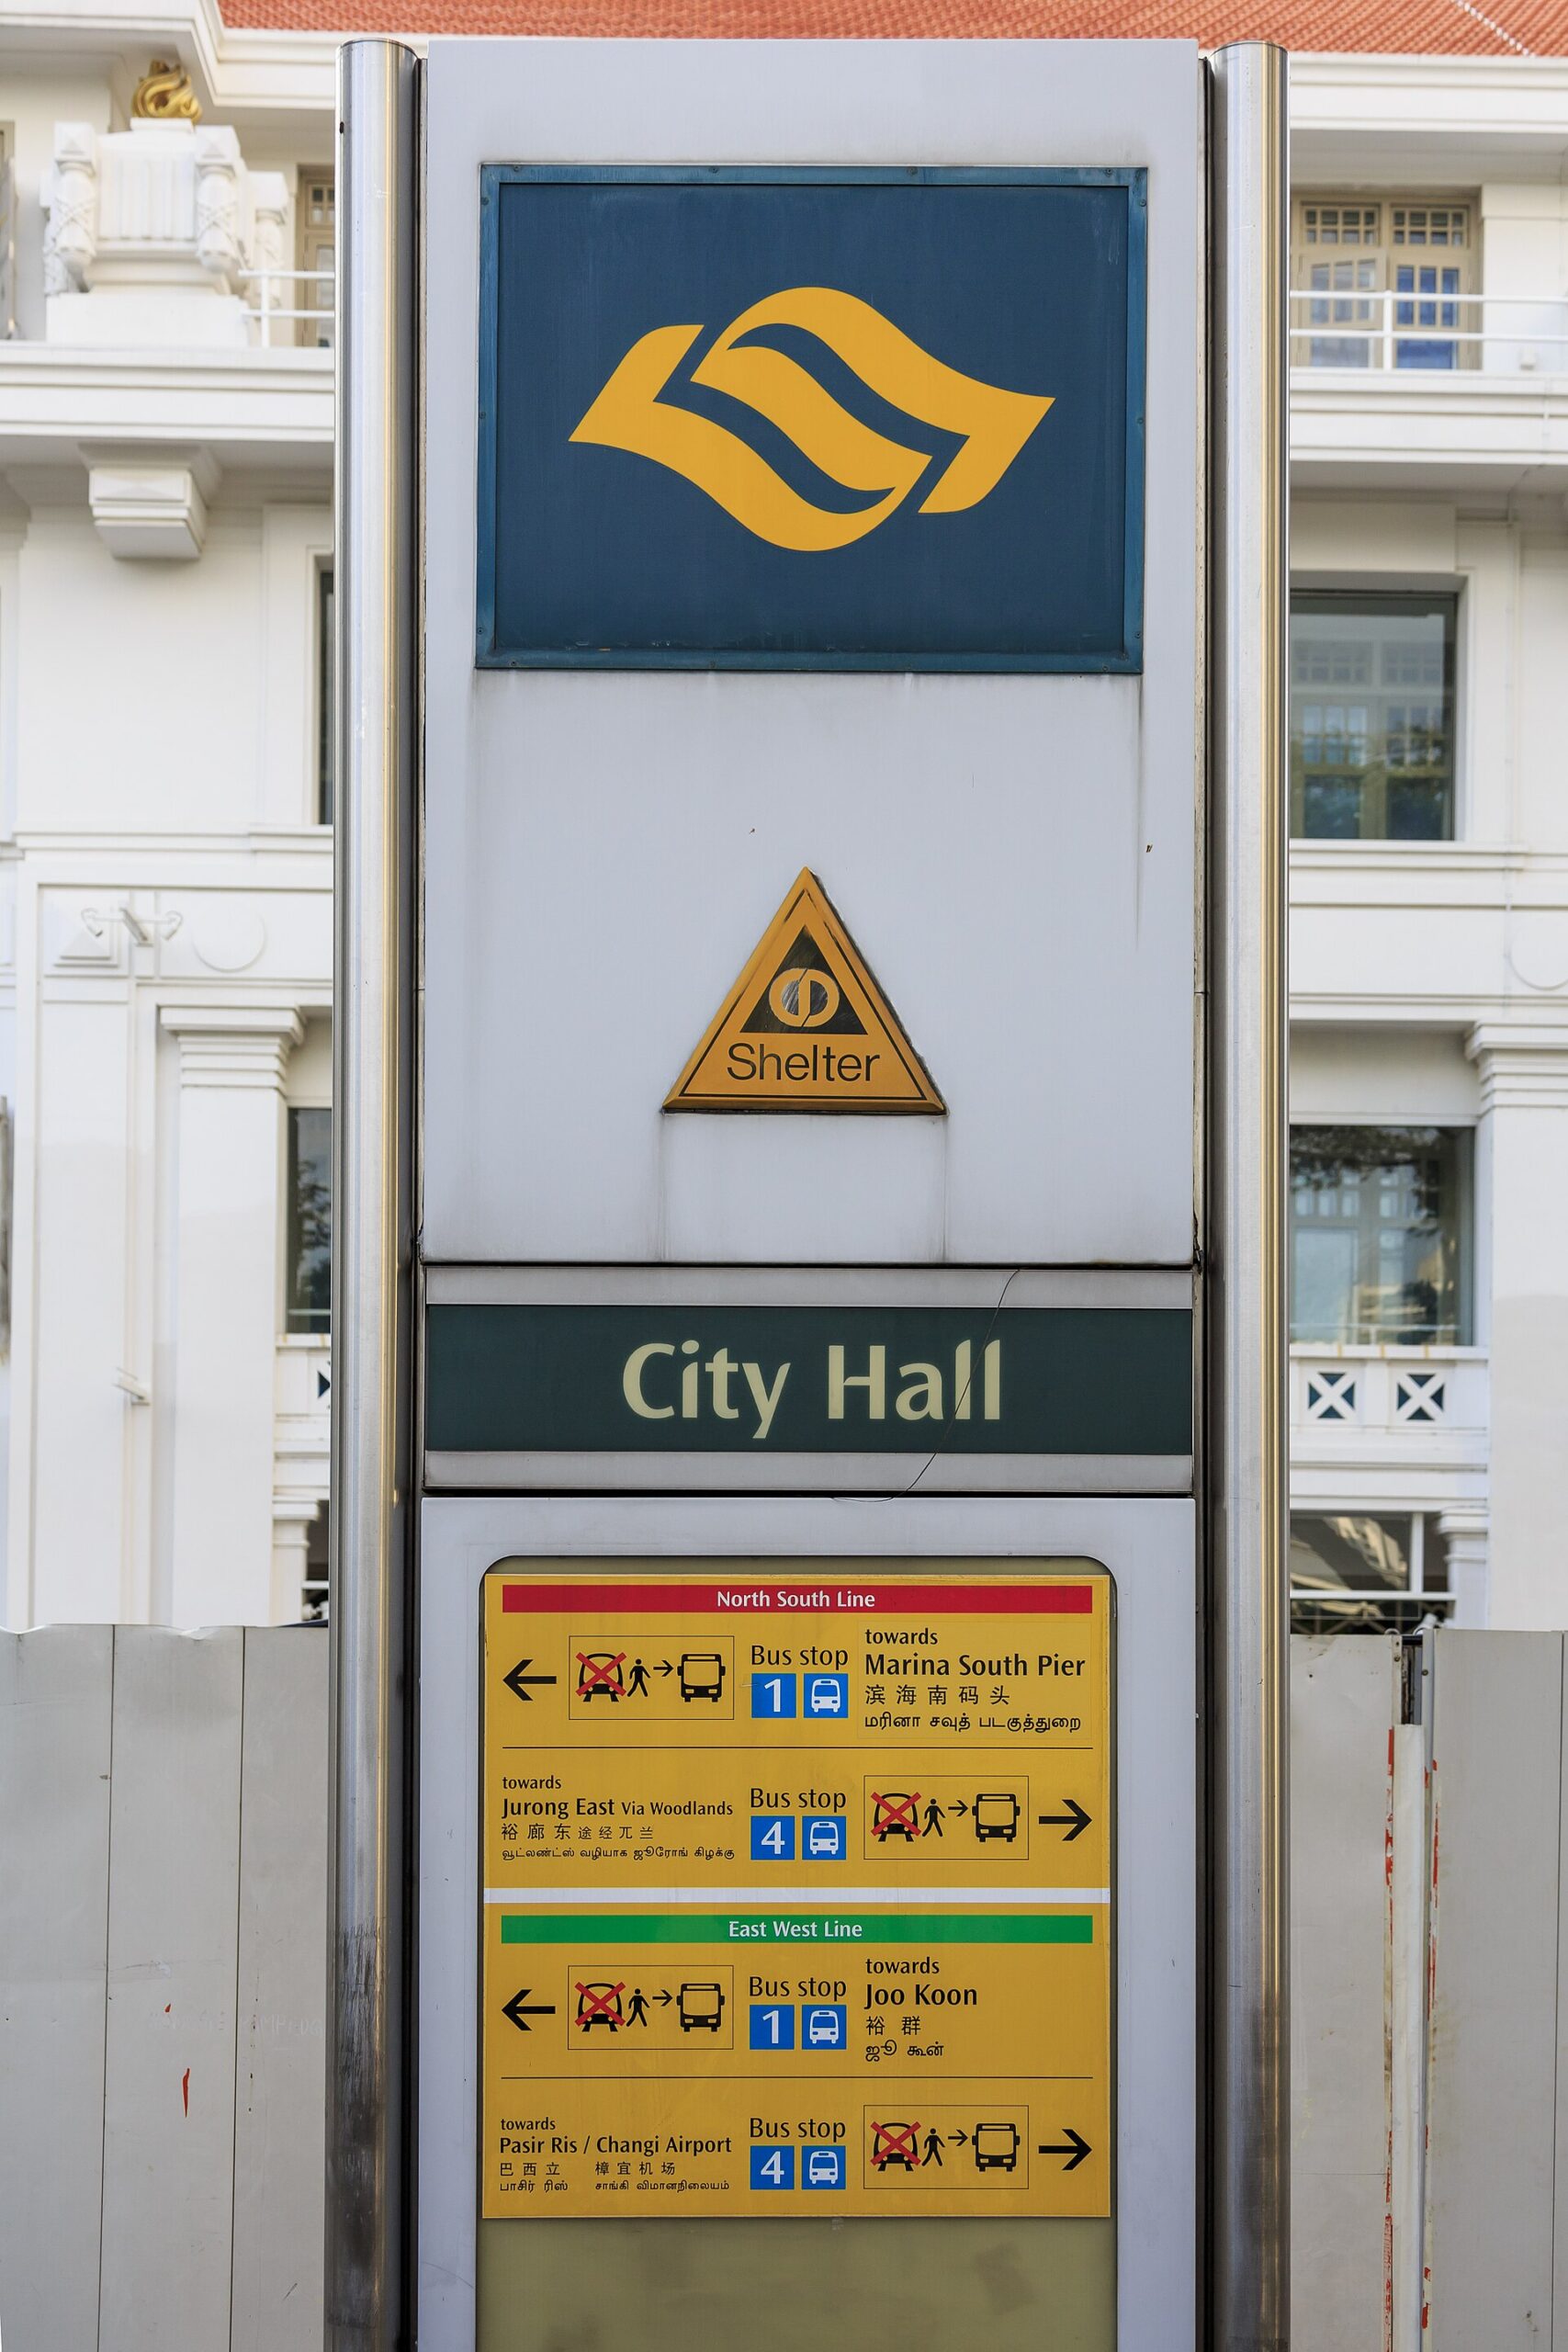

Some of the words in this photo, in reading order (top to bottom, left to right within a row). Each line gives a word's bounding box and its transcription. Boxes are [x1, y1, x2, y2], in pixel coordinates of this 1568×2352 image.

[727, 1042, 881, 1082] Shelter
[622, 1340, 791, 1439] City
[828, 1339, 1000, 1420] Hall
[717, 1589, 771, 1607] North
[777, 1589, 830, 1607] South
[837, 1590, 875, 1608] Line
[864, 1627, 938, 1645] towards
[751, 1645, 792, 1666] Bus
[799, 1645, 849, 1670] stop
[865, 1652, 950, 1676] Marina
[959, 1653, 1028, 1677] South
[1038, 1653, 1086, 1677] Pier
[763, 1679, 781, 1713] 1
[864, 1683, 1010, 1705] 滨海南码头
[502, 1774, 562, 1790] towards
[501, 1798, 570, 1820] Jurong
[576, 1798, 615, 1815] East
[621, 1800, 645, 1815] Via
[649, 1800, 733, 1815] Woodlands
[750, 1787, 791, 1809] Bus
[798, 1789, 847, 1814] stop
[761, 1821, 785, 1855] 4
[728, 1920, 767, 1938] East
[773, 1920, 818, 1938] West
[824, 1920, 863, 1938] Line
[865, 1956, 940, 1974] towards
[749, 1976, 790, 1997] Bus
[797, 1977, 847, 2002] stop
[863, 1984, 905, 2010] Joo
[915, 1984, 977, 2006] Koon
[762, 2009, 779, 2044] 1
[865, 2015, 921, 2036] 裕群
[500, 2116, 556, 2131] towards
[750, 2117, 790, 2138] Bus
[797, 2118, 846, 2143] stop
[500, 2135, 545, 2154] Pasir
[551, 2135, 578, 2154] Ris
[582, 2134, 591, 2154] /
[596, 2135, 660, 2157] Changi
[665, 2135, 732, 2157] Airport
[500, 2161, 560, 2177] 巴西立
[761, 2151, 785, 2185] 4
